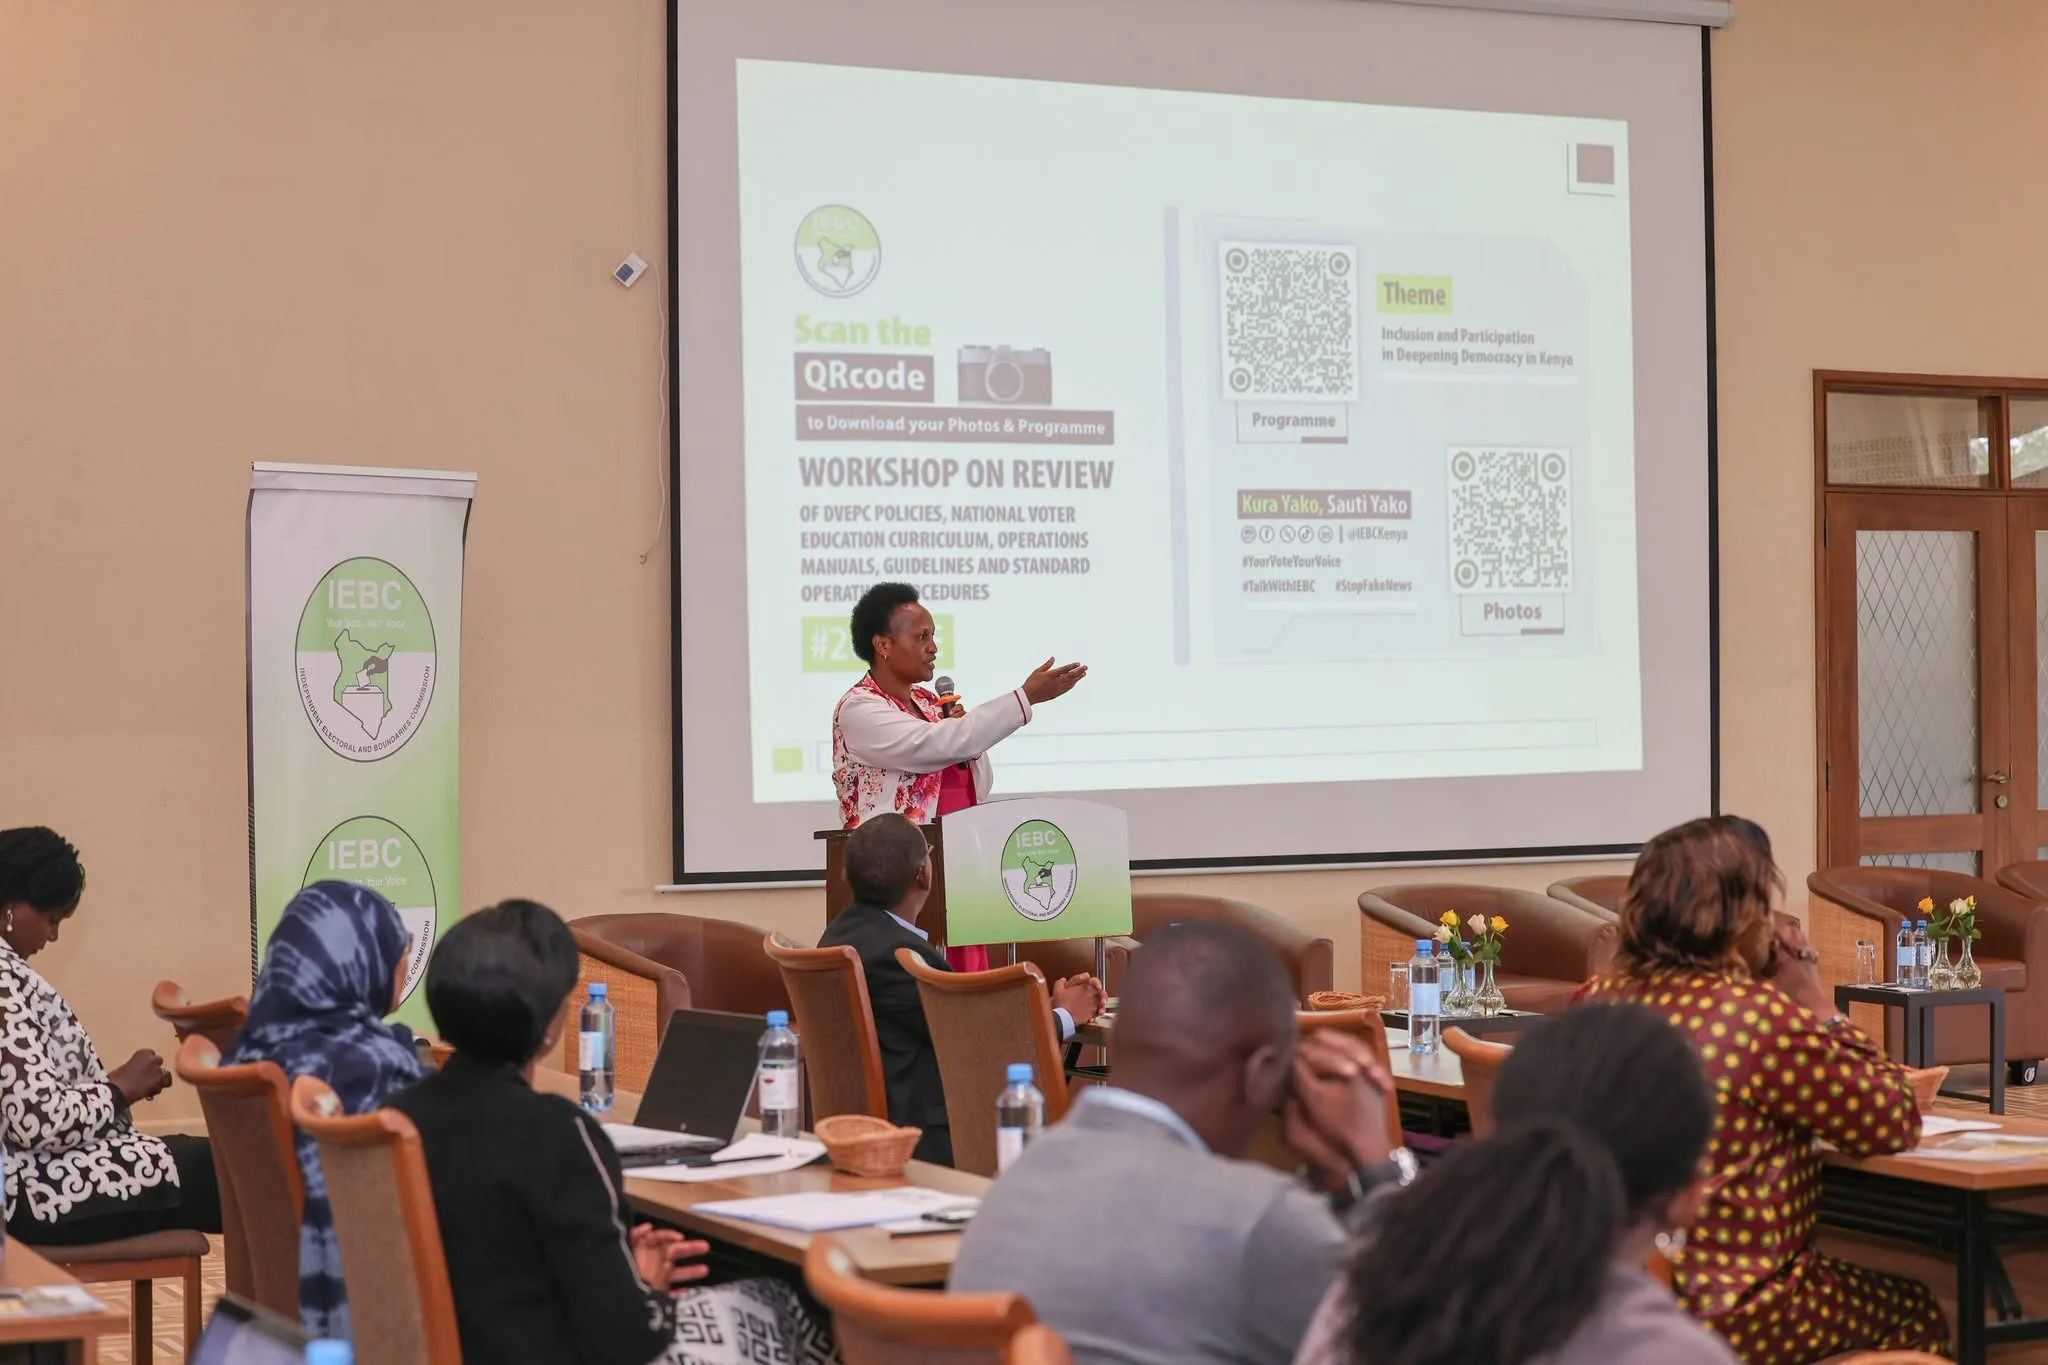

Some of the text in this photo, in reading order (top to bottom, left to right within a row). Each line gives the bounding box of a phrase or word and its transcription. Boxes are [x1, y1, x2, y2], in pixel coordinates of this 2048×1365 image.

[1383, 281, 1446, 305] Theme
[794, 314, 932, 346] Scan the
[1382, 326, 1535, 346] Inclusion and Participation
[1382, 347, 1573, 368] in Deepening Democracy in Kenya
[804, 360, 925, 392] QRcode
[807, 415, 1105, 438] to Download your Photos & Programme
[1252, 412, 1336, 429] Programme
[799, 457, 1115, 489] WORKSHOP ON REVIEW
[1242, 493, 1408, 516] Kura Yako, Sauti Yako
[800, 505, 1076, 525] OF DVEPC POLICIES, NATIONAL VOTER
[800, 531, 1089, 551] EDUCATION CURRICULUM, OPERATIONS
[1347, 526, 1408, 543] @IEBCKenya
[800, 557, 1091, 577] MANUALS, GUIDELINES AND STANDARD
[1242, 554, 1342, 569] #YourVoteYourVoice
[328, 578, 402, 611] IEBC
[801, 584, 869, 602] OPERATI
[1242, 578, 1413, 594] #TalkWithIEBC #StopFakeNews
[1483, 602, 1543, 620] Photos
[299, 665, 431, 753] INDEPENDENT ELECTORAL AND BOUNDARIES COMMISSION
[1016, 830, 1057, 849] IEBC
[328, 838, 402, 870] IEBC
[411, 920, 431, 975] COMMISSION
